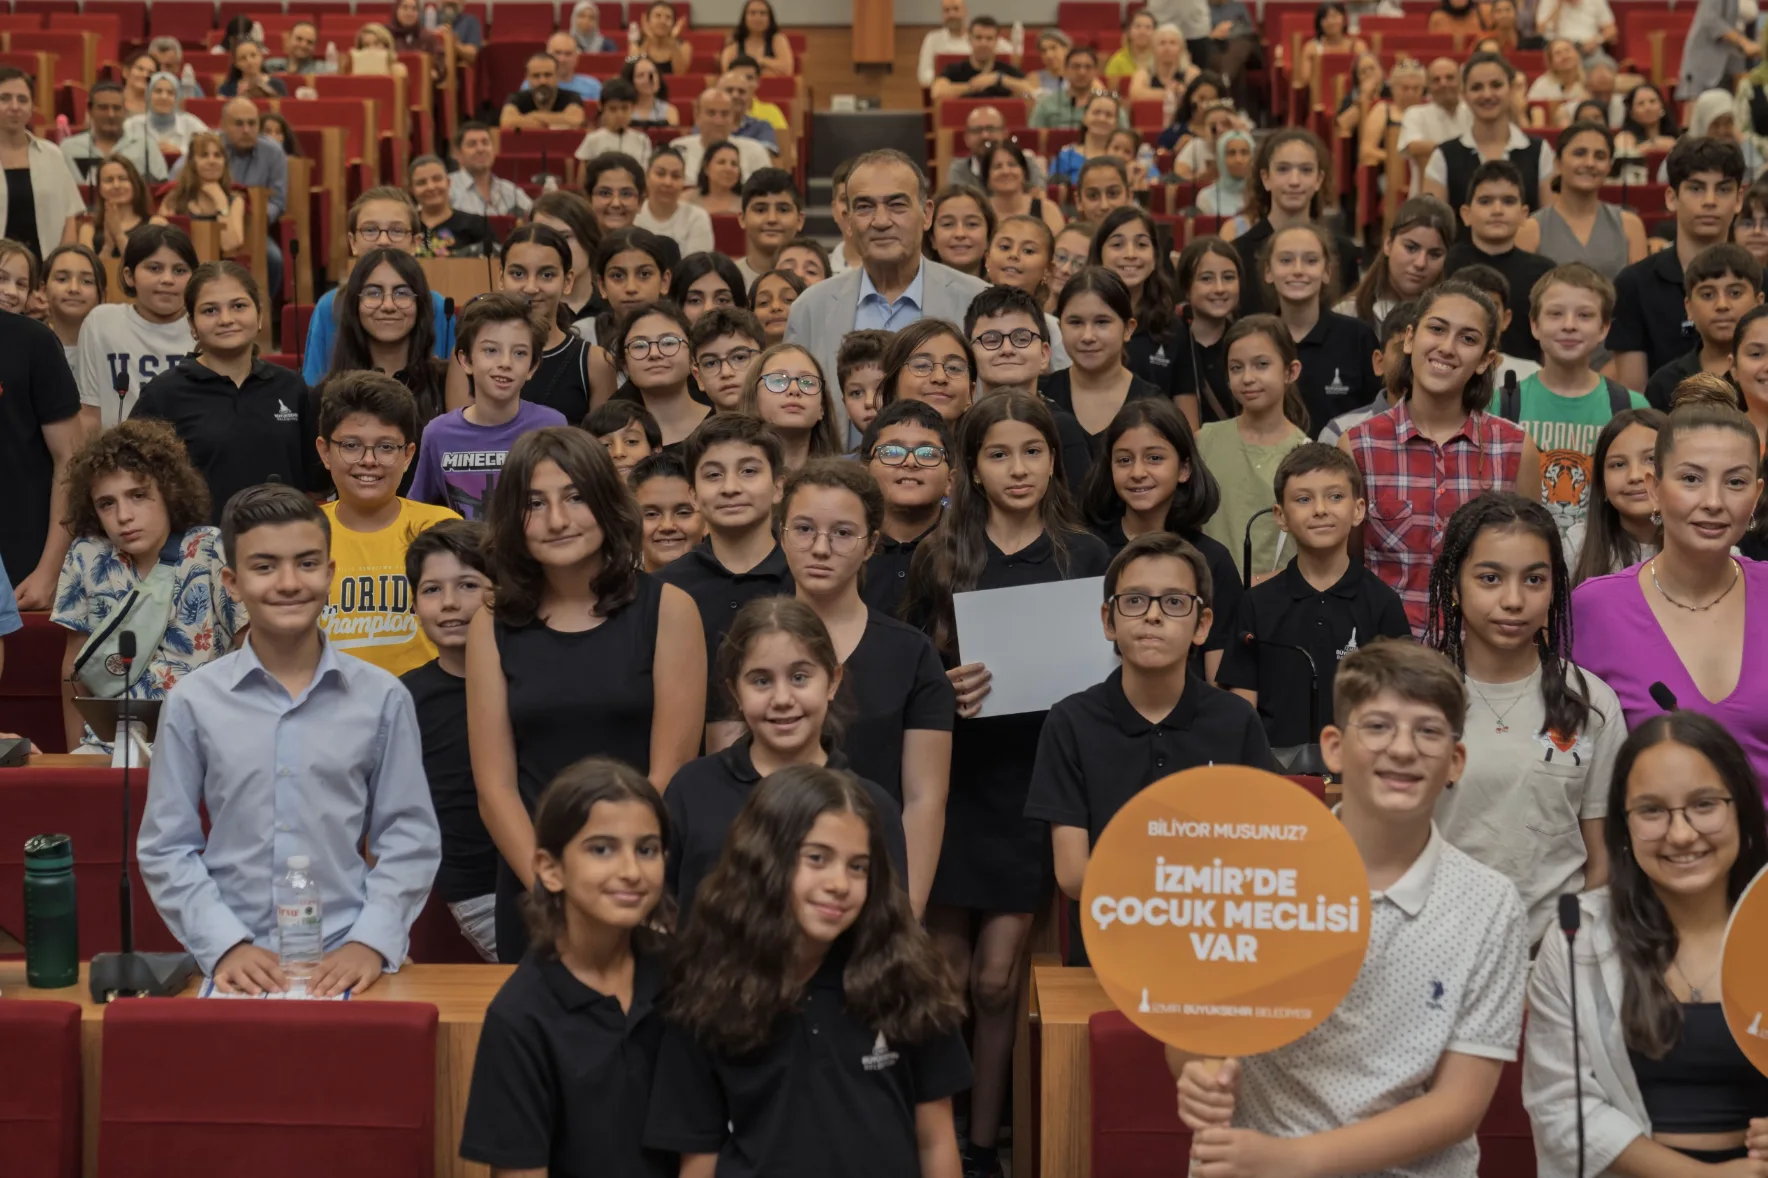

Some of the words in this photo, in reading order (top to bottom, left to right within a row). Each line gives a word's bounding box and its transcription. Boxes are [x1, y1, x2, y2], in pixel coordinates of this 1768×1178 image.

[442, 451, 508, 471] MINECR
[1148, 818, 1210, 837] BİLİYOR
[1214, 822, 1307, 840] MUSUNUZ?
[1155, 856, 1297, 897] İZMİR'DE
[1091, 896, 1216, 930] ÇOCUK
[1224, 895, 1359, 932] MECLİSİ
[1189, 932, 1258, 962] VAR
